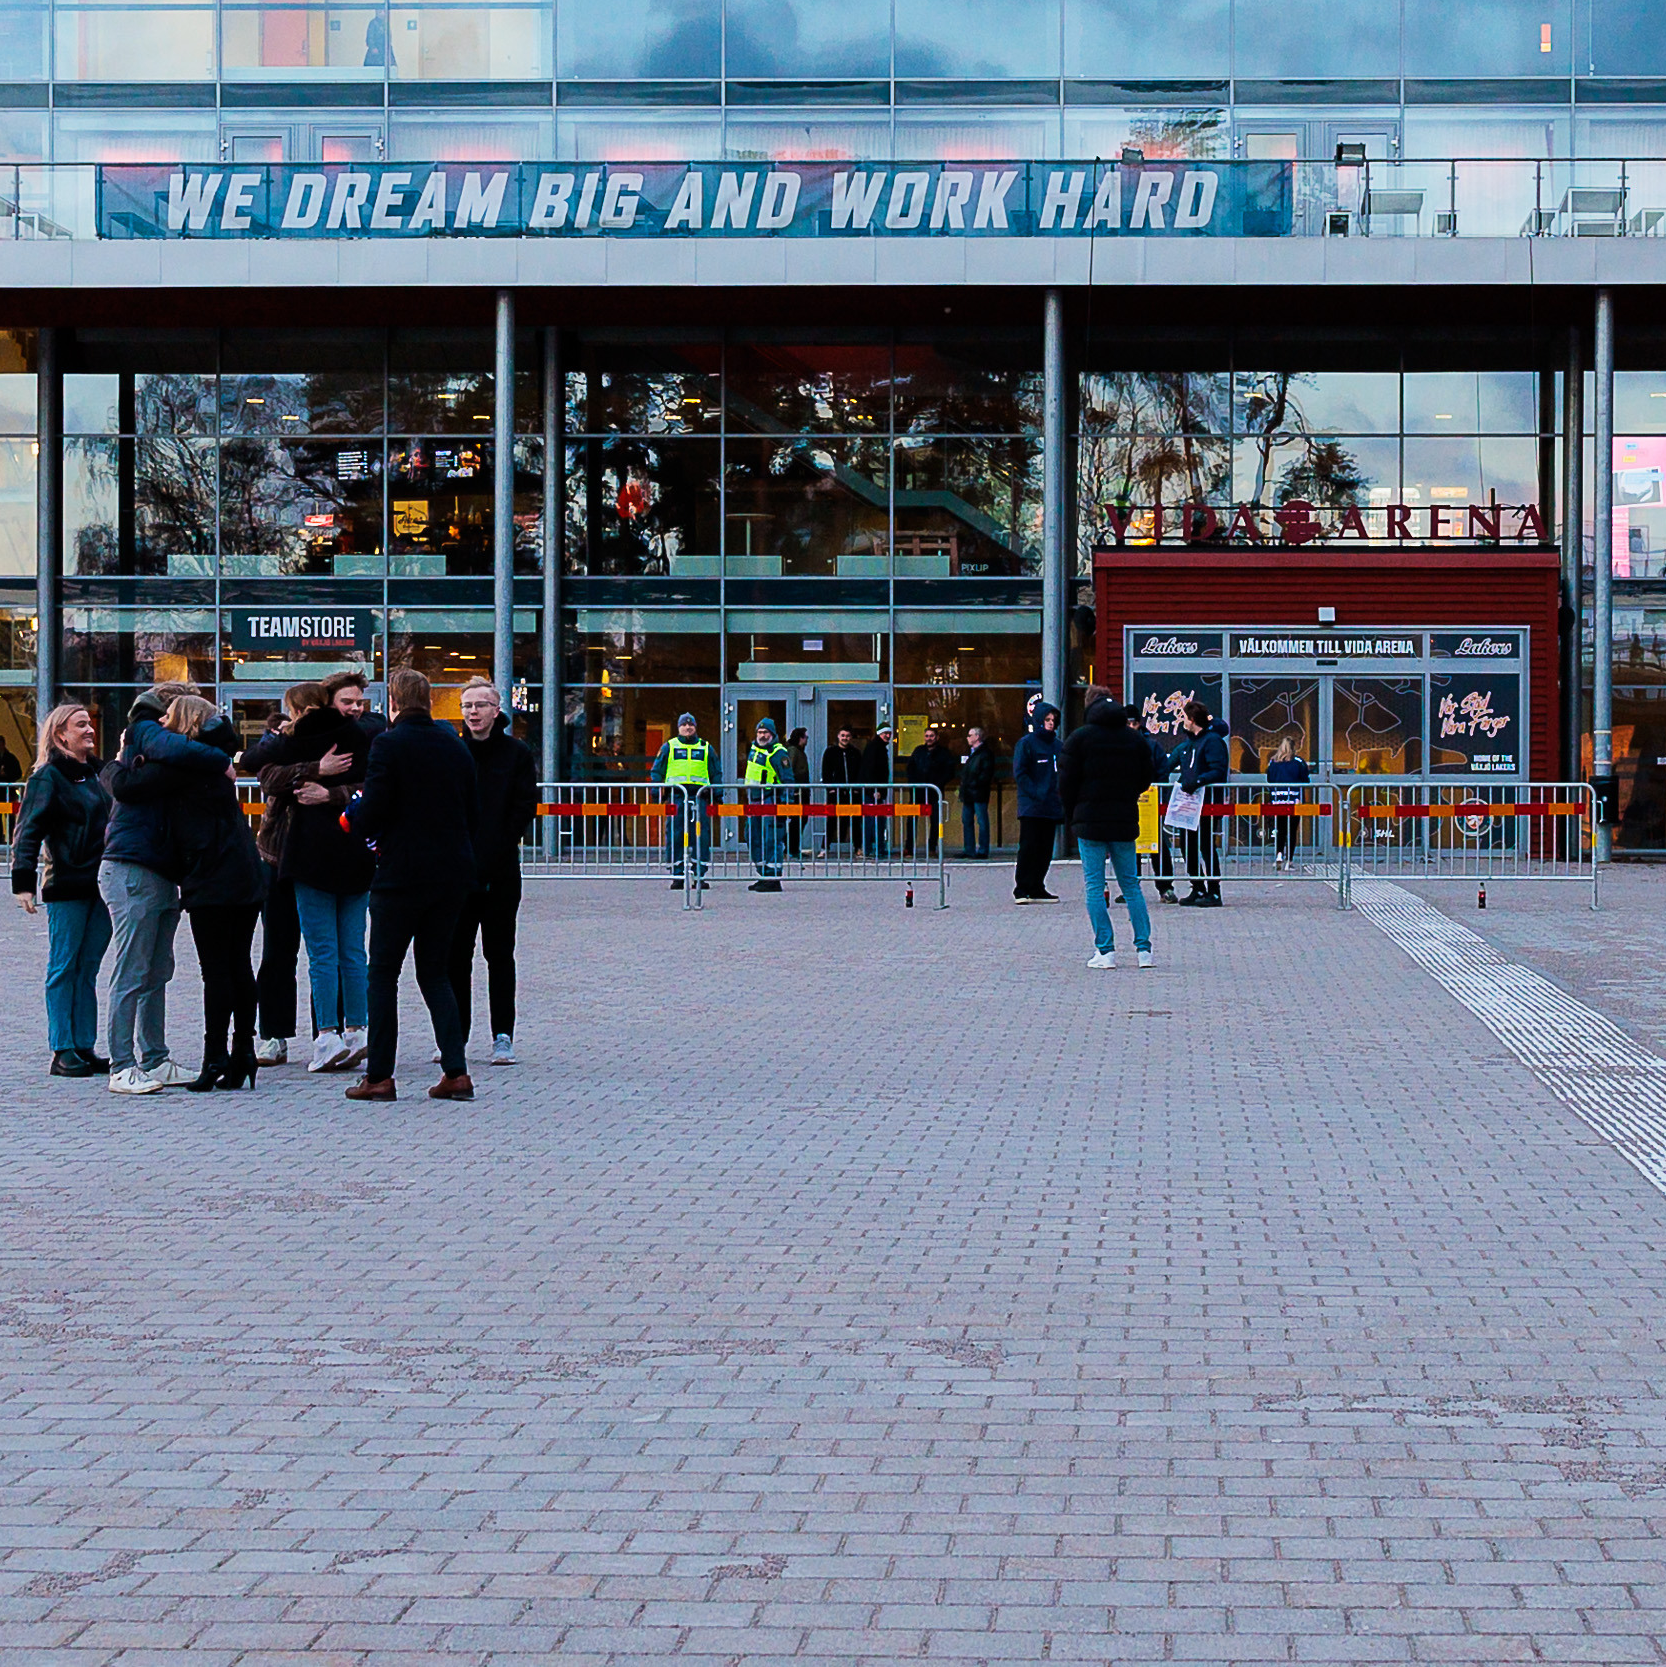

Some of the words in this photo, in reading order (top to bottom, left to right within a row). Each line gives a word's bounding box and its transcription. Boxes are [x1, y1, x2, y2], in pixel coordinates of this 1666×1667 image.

[167, 172, 269, 230] WE
[281, 172, 511, 229] DREAM
[529, 172, 645, 229] BIG
[663, 171, 803, 229] AND
[832, 170, 1021, 229] WORK
[1038, 170, 1220, 229] HARD
[1105, 503, 1259, 542] VIDA
[1338, 502, 1551, 540] ARENA
[247, 616, 355, 638] TEAMSTORE
[1141, 636, 1198, 655] Lakers
[1239, 639, 1314, 655] VÄLKOMMEN
[1317, 640, 1343, 654] TILL
[1345, 640, 1373, 654] VIDA
[1375, 639, 1415, 654] ARENA
[1455, 636, 1512, 655] Lakers
